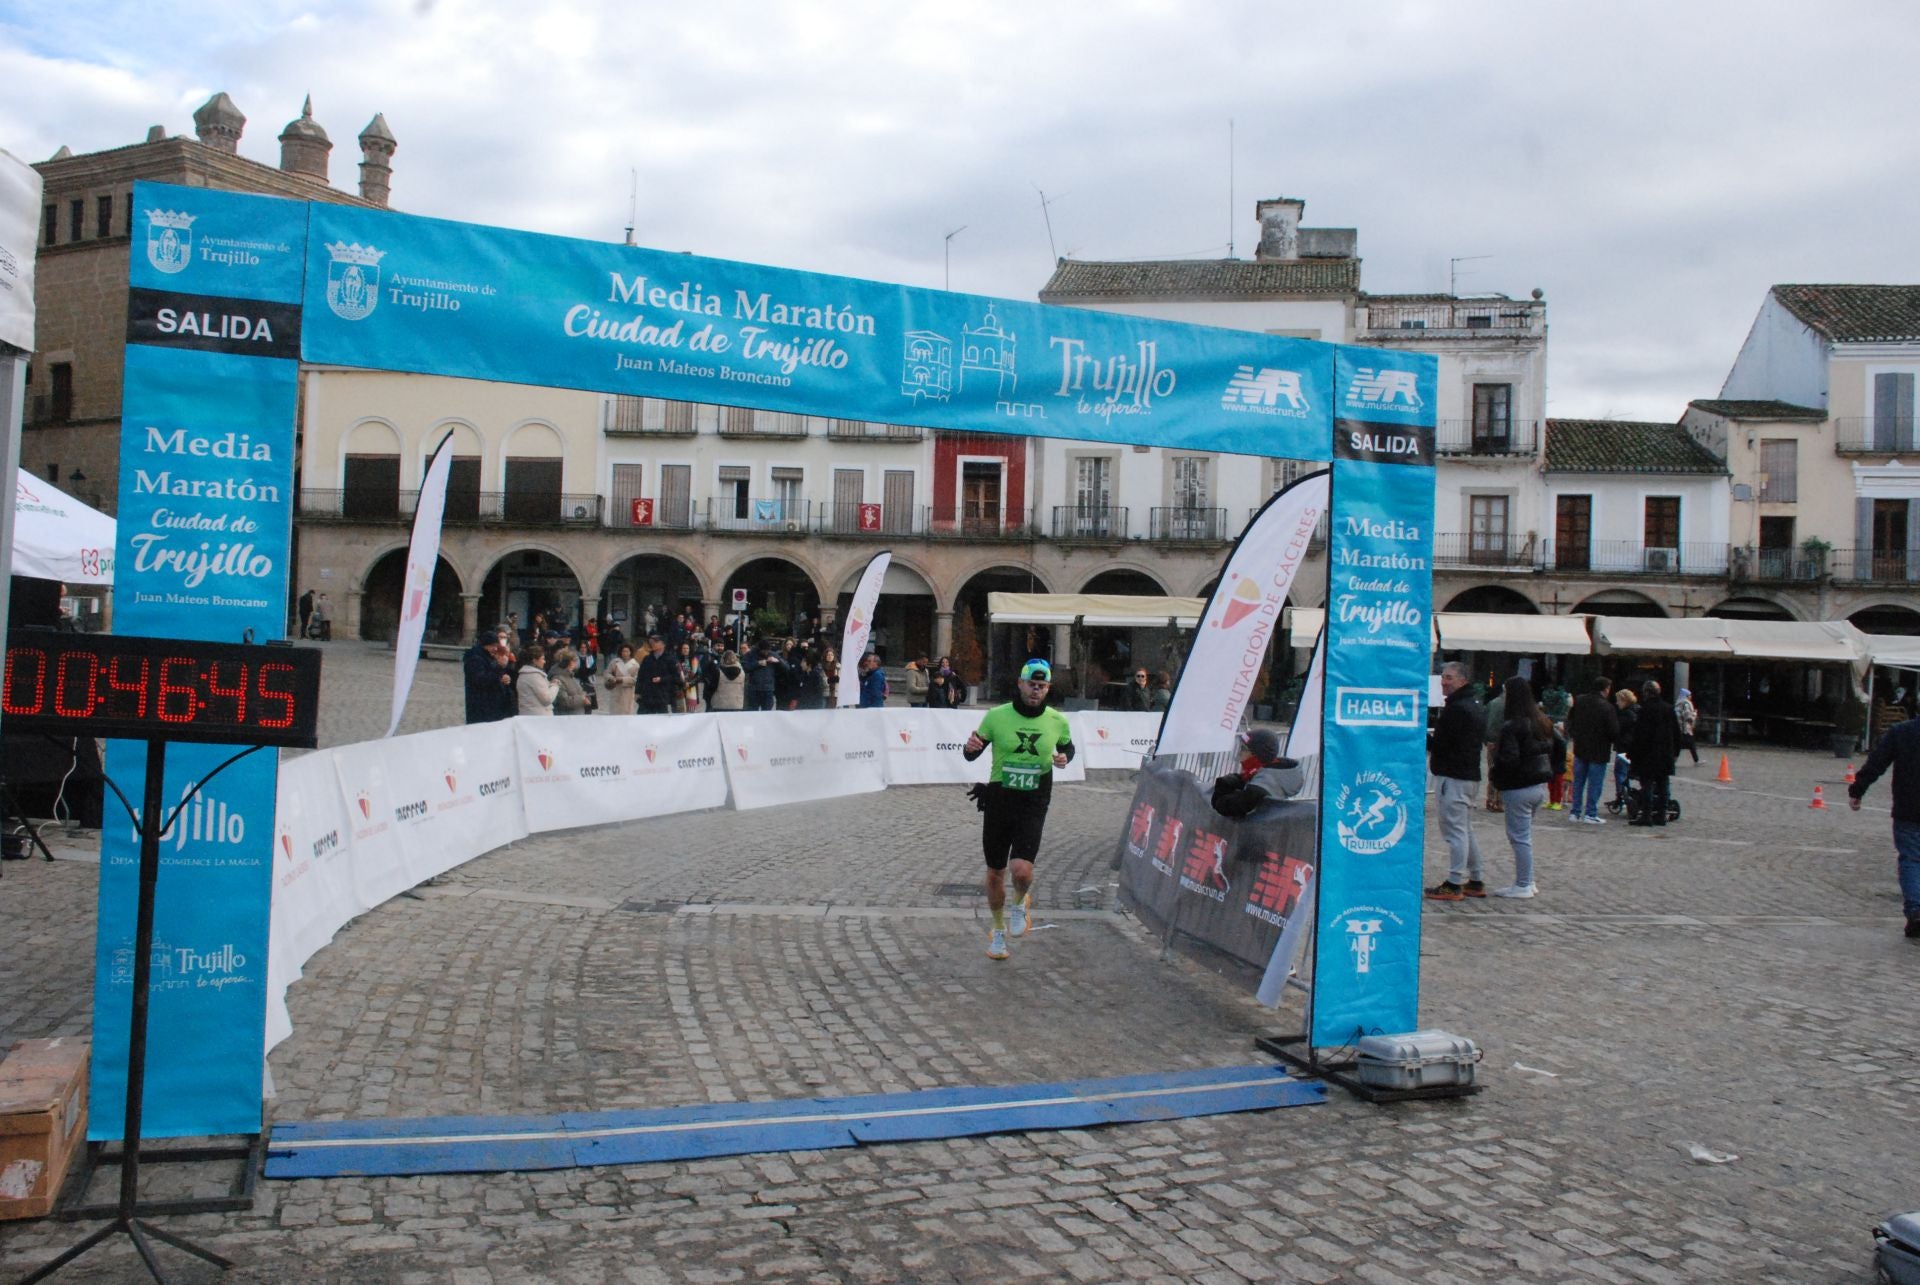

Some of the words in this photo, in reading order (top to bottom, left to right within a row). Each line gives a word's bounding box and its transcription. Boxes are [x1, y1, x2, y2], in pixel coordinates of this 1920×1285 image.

[201, 235, 275, 251] Ayuntamiento
[276, 242, 291, 253] de
[200, 248, 260, 267] Trujillo
[391, 273, 479, 294] Ayuntamiento
[480, 284, 497, 296] de
[388, 287, 461, 312] Trujillo
[608, 271, 722, 317] Media
[733, 289, 877, 337] Maratón
[156, 308, 273, 342] SALIDA
[563, 304, 691, 348] Ciudad
[689, 324, 733, 354] de
[740, 326, 849, 375] Trujillo
[615, 353, 653, 371] Juan
[658, 357, 715, 379] Mateos
[719, 365, 791, 388] Broncano
[1050, 336, 1176, 409] Trujillo
[1077, 393, 1092, 415] te
[1221, 402, 1308, 419] www.musicrun.es
[144, 426, 273, 462] Media
[1350, 431, 1420, 455] SALIDA
[133, 469, 280, 503] Maratón
[151, 508, 228, 532] Ciudad
[230, 515, 259, 534] de
[1344, 516, 1420, 541] Media
[130, 533, 273, 589] Trujillo
[1339, 547, 1425, 571] Maratón
[1348, 575, 1392, 593] Ciudad
[1393, 580, 1411, 594] de
[134, 591, 163, 605] Juan
[166, 592, 209, 606] Mateos
[212, 595, 268, 608] Broncano
[1337, 594, 1422, 634] Trujillo
[1219, 620, 1270, 731] DIPUTACIÓN
[1261, 593, 1281, 618] DE
[2, 647, 295, 728] 00:46:45
[1347, 699, 1406, 716] HABLA
[1008, 773, 1034, 787] 214
[1335, 783, 1351, 811] Club
[1355, 770, 1403, 797] Atletismo
[131, 781, 245, 852] tujillo
[214, 857, 226, 866] LA
[229, 857, 261, 866] MAGIA
[175, 943, 246, 975] Trujillo
